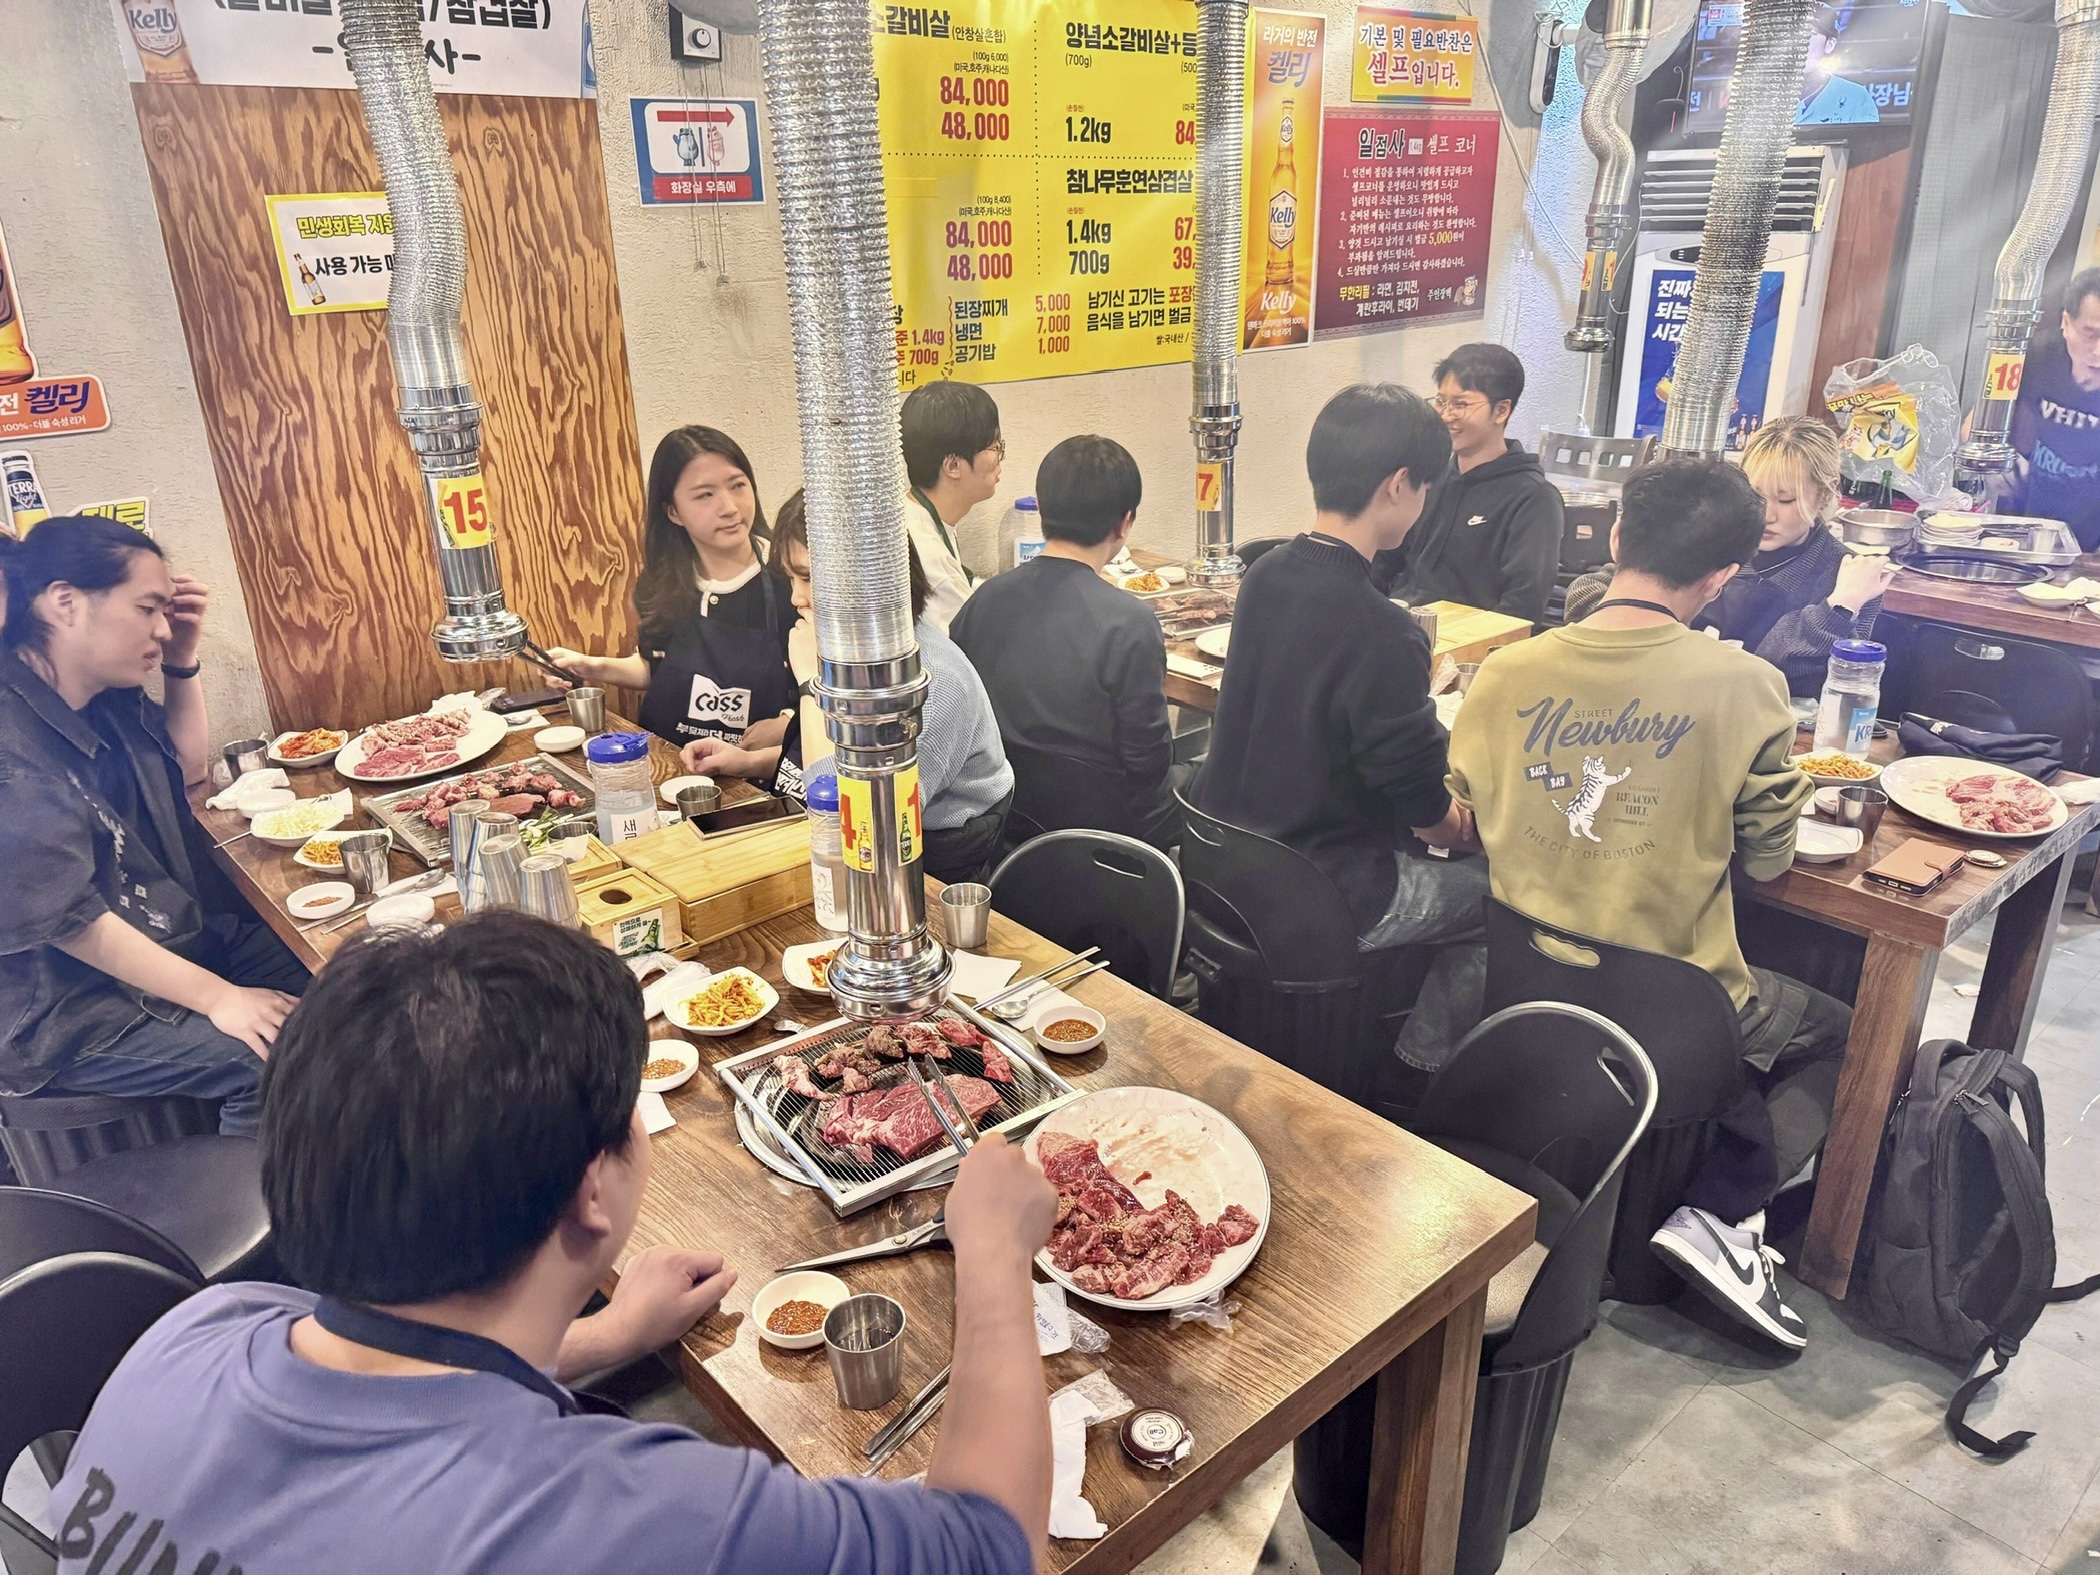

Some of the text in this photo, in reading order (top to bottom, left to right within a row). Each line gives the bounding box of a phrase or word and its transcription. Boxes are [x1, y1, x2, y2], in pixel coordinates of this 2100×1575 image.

[128, 8, 177, 33] Kelly
[1263, 25, 1318, 47] 라거의 반전
[1360, 26, 1472, 53] 기본 및 필요반찬은
[1065, 53, 1092, 69] (700g)
[1267, 50, 1311, 88] 켈리
[940, 76, 1009, 107] 84,000
[941, 112, 1010, 141] 48,000
[1066, 116, 1111, 144] 1.2kg
[1358, 127, 1405, 159] 일점사
[1427, 134, 1449, 155] 셀프
[1454, 135, 1476, 155] 코너
[670, 180, 703, 194] 화장실
[1066, 169, 1193, 194] 참나무훈연삼겹살
[297, 215, 366, 239] 민생회복
[1270, 207, 1296, 228] Kelly
[945, 220, 1012, 249] 84,000
[1066, 219, 1111, 244] 1.4kg
[315, 257, 347, 276] 사용
[350, 255, 382, 274] 가능
[947, 253, 1013, 281] 48,000
[1069, 250, 1110, 275] 700g
[1088, 290, 1124, 309] 남기신
[1128, 287, 1165, 306] 고기는
[1658, 280, 1694, 298] 진짜
[954, 293, 1070, 319] 된장찌개 5,000
[1261, 290, 1297, 314] Kelly
[1654, 302, 1688, 320] 되는
[955, 314, 1070, 342] 냉면 7,000
[1087, 306, 1192, 331] 음식을 남기면 벌금
[912, 328, 945, 346] 1.4kg
[955, 336, 1070, 363] 공기밥 1,000
[909, 348, 939, 365] 700g
[1995, 363, 2022, 391] 18
[24, 381, 90, 414] 켈리
[52, 416, 69, 427] 숙성
[69, 415, 86, 426] 라거
[1198, 472, 1213, 501] 7
[443, 488, 488, 534] 15
[1574, 708, 1614, 719] STREET
[1517, 696, 1696, 760] Newbury
[1529, 764, 1548, 778] BACK
[1550, 776, 1566, 788] BAY
[1616, 792, 1659, 806] BEACON
[1524, 826, 1548, 847] THE
[1549, 840, 1578, 859] CITY
[1583, 849, 1600, 860] OF
